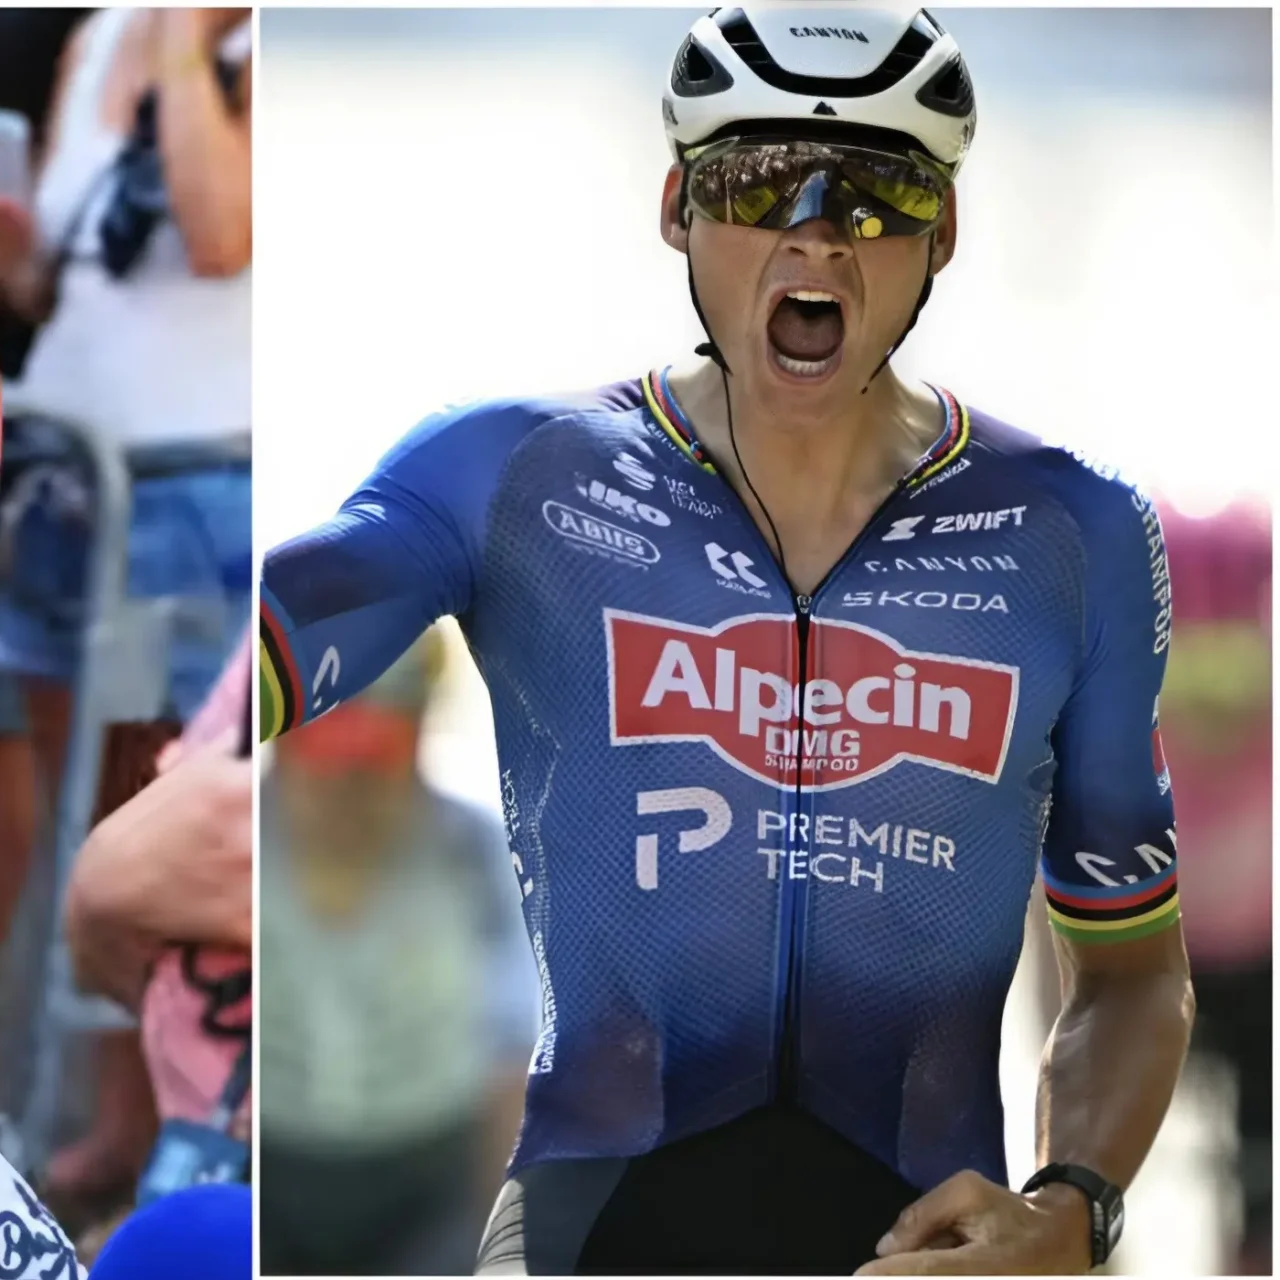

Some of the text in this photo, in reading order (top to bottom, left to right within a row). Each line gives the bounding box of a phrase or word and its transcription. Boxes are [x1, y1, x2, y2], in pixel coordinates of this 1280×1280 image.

[789, 26, 869, 44] CANYON
[559, 509, 645, 556] ABUS
[931, 505, 1027, 534] ZWIFT
[864, 554, 1020, 572] CANYON
[841, 590, 1010, 614] SKODA
[640, 639, 972, 741] Alpecin
[756, 808, 957, 872] PREMIER
[756, 847, 884, 893] TECH
